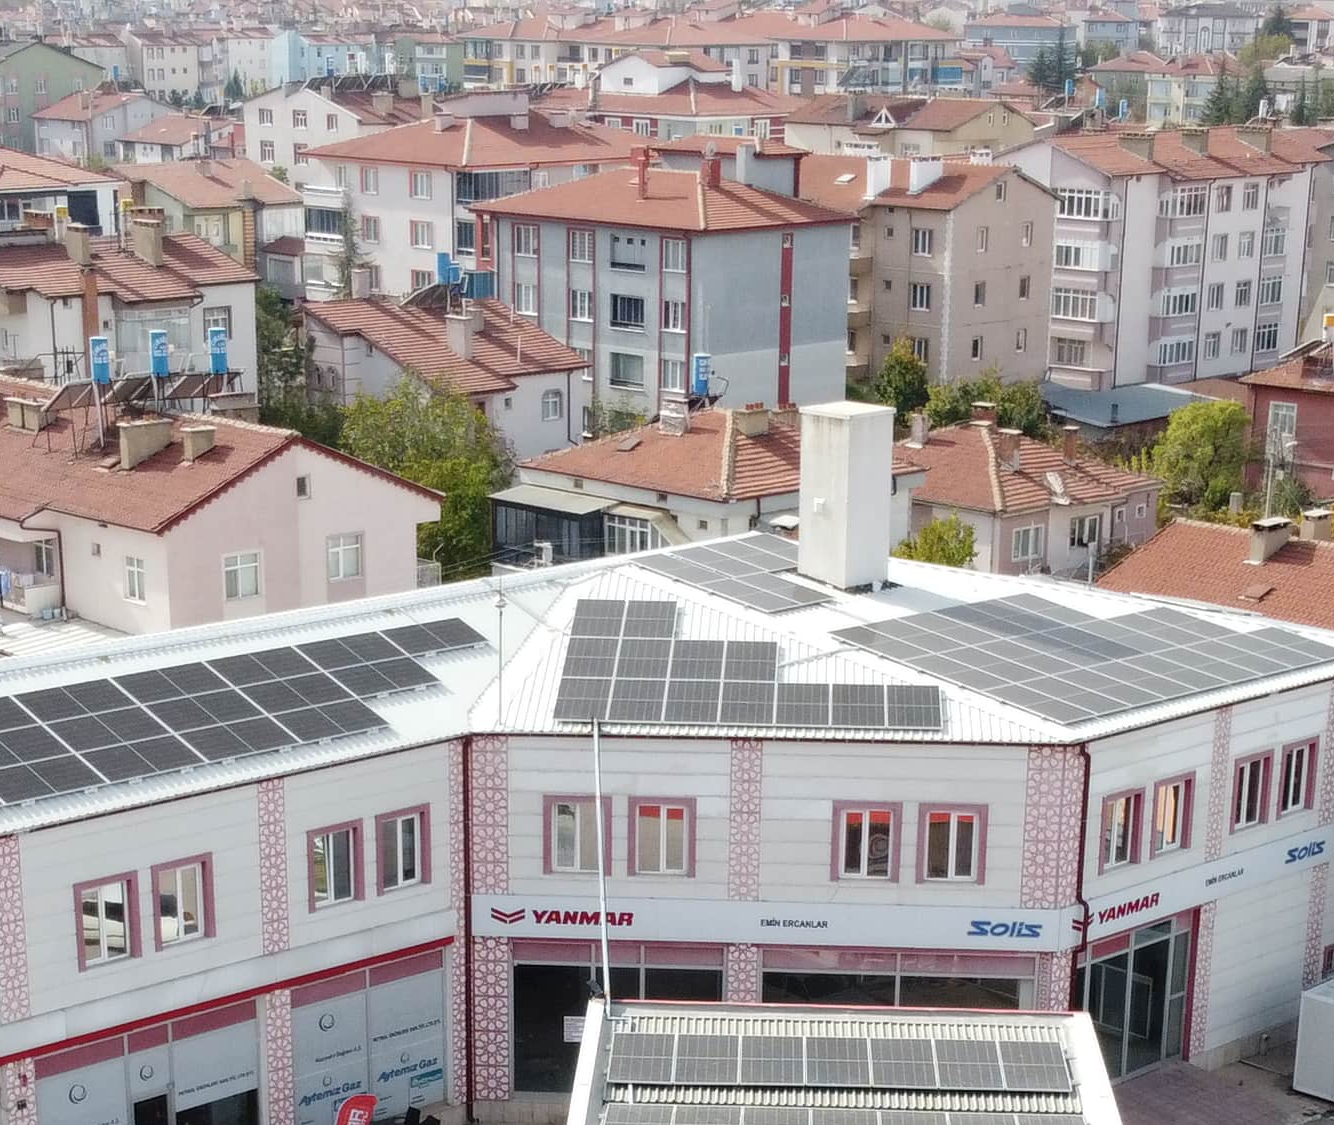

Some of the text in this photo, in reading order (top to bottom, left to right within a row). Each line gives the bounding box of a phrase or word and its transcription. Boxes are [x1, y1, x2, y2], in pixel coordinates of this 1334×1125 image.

[1098, 892, 1160, 925] YANMAR
[532, 909, 635, 926] YANMAR
[782, 918, 828, 928] ERCANLAR
[419, 1057, 438, 1070] Gaz
[342, 1079, 363, 1093] Gaz
